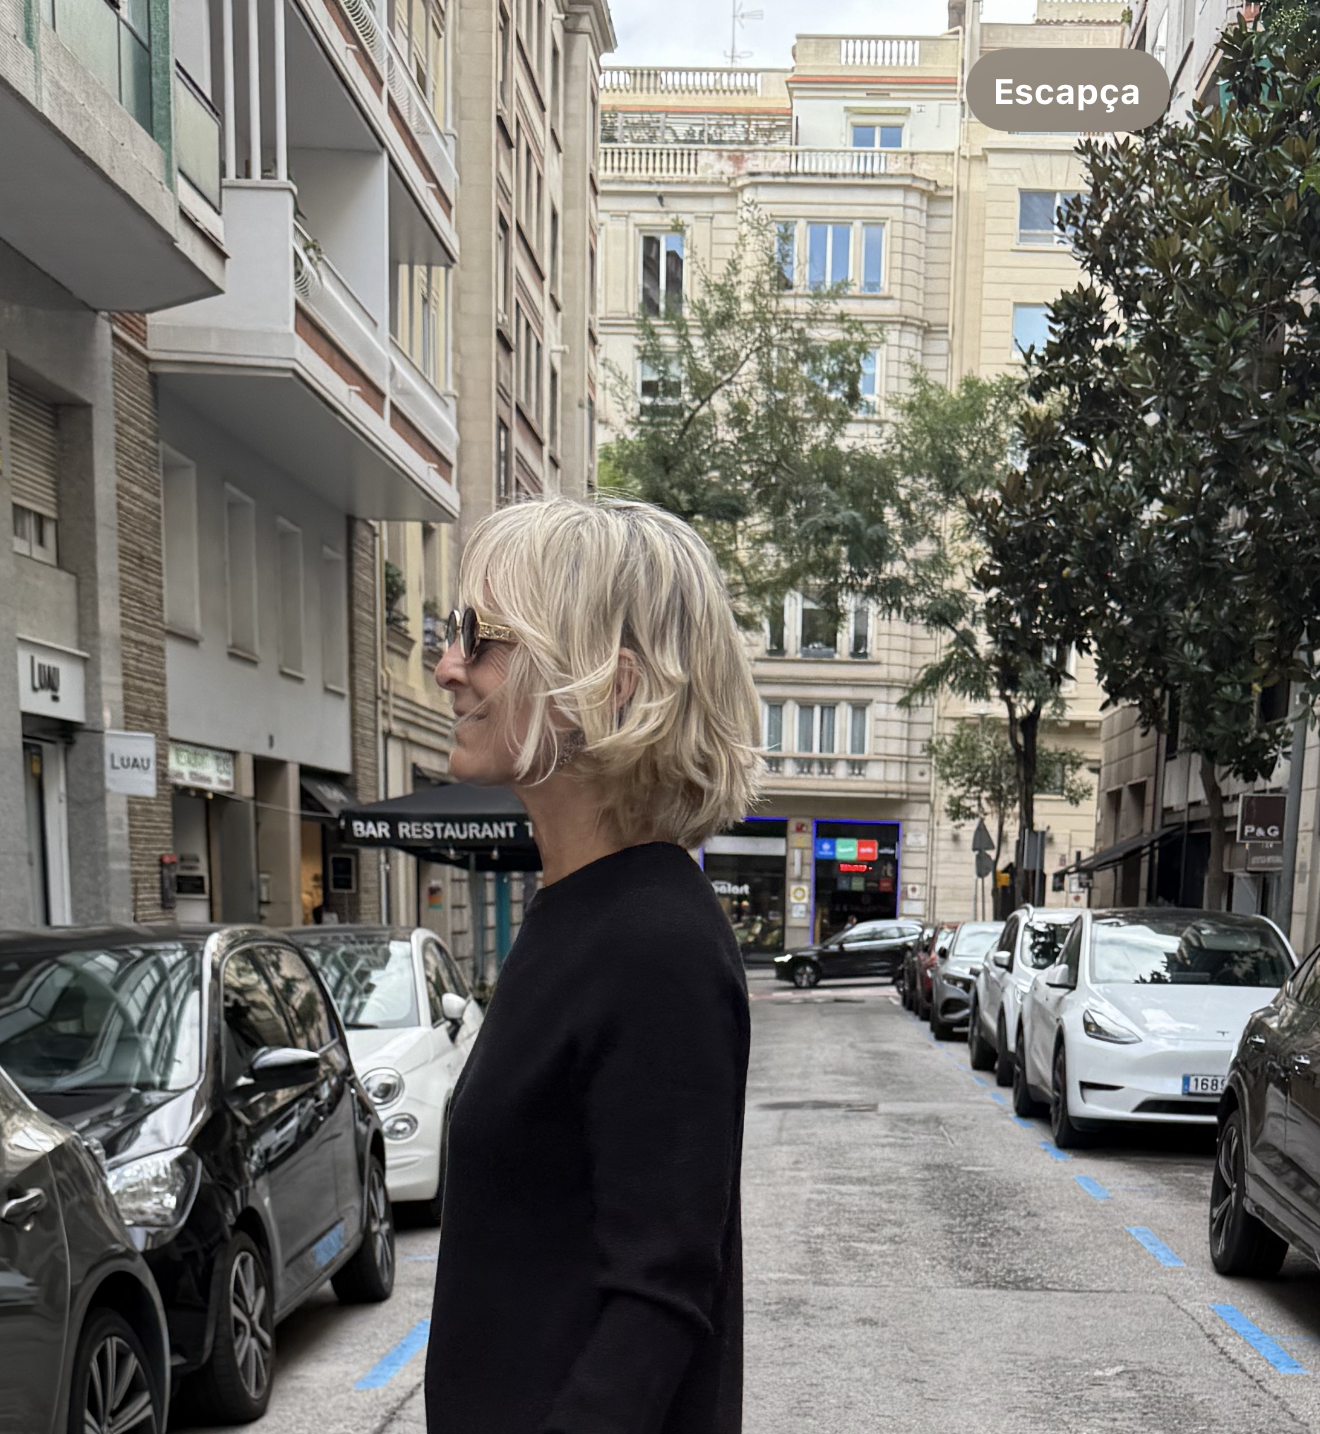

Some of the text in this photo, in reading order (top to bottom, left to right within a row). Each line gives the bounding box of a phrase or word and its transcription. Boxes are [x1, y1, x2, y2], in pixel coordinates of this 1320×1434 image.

[110, 752, 151, 771] LUAU
[352, 820, 390, 839] BAR
[398, 821, 518, 840] RESTAURANT
[1244, 824, 1280, 838] P&G
